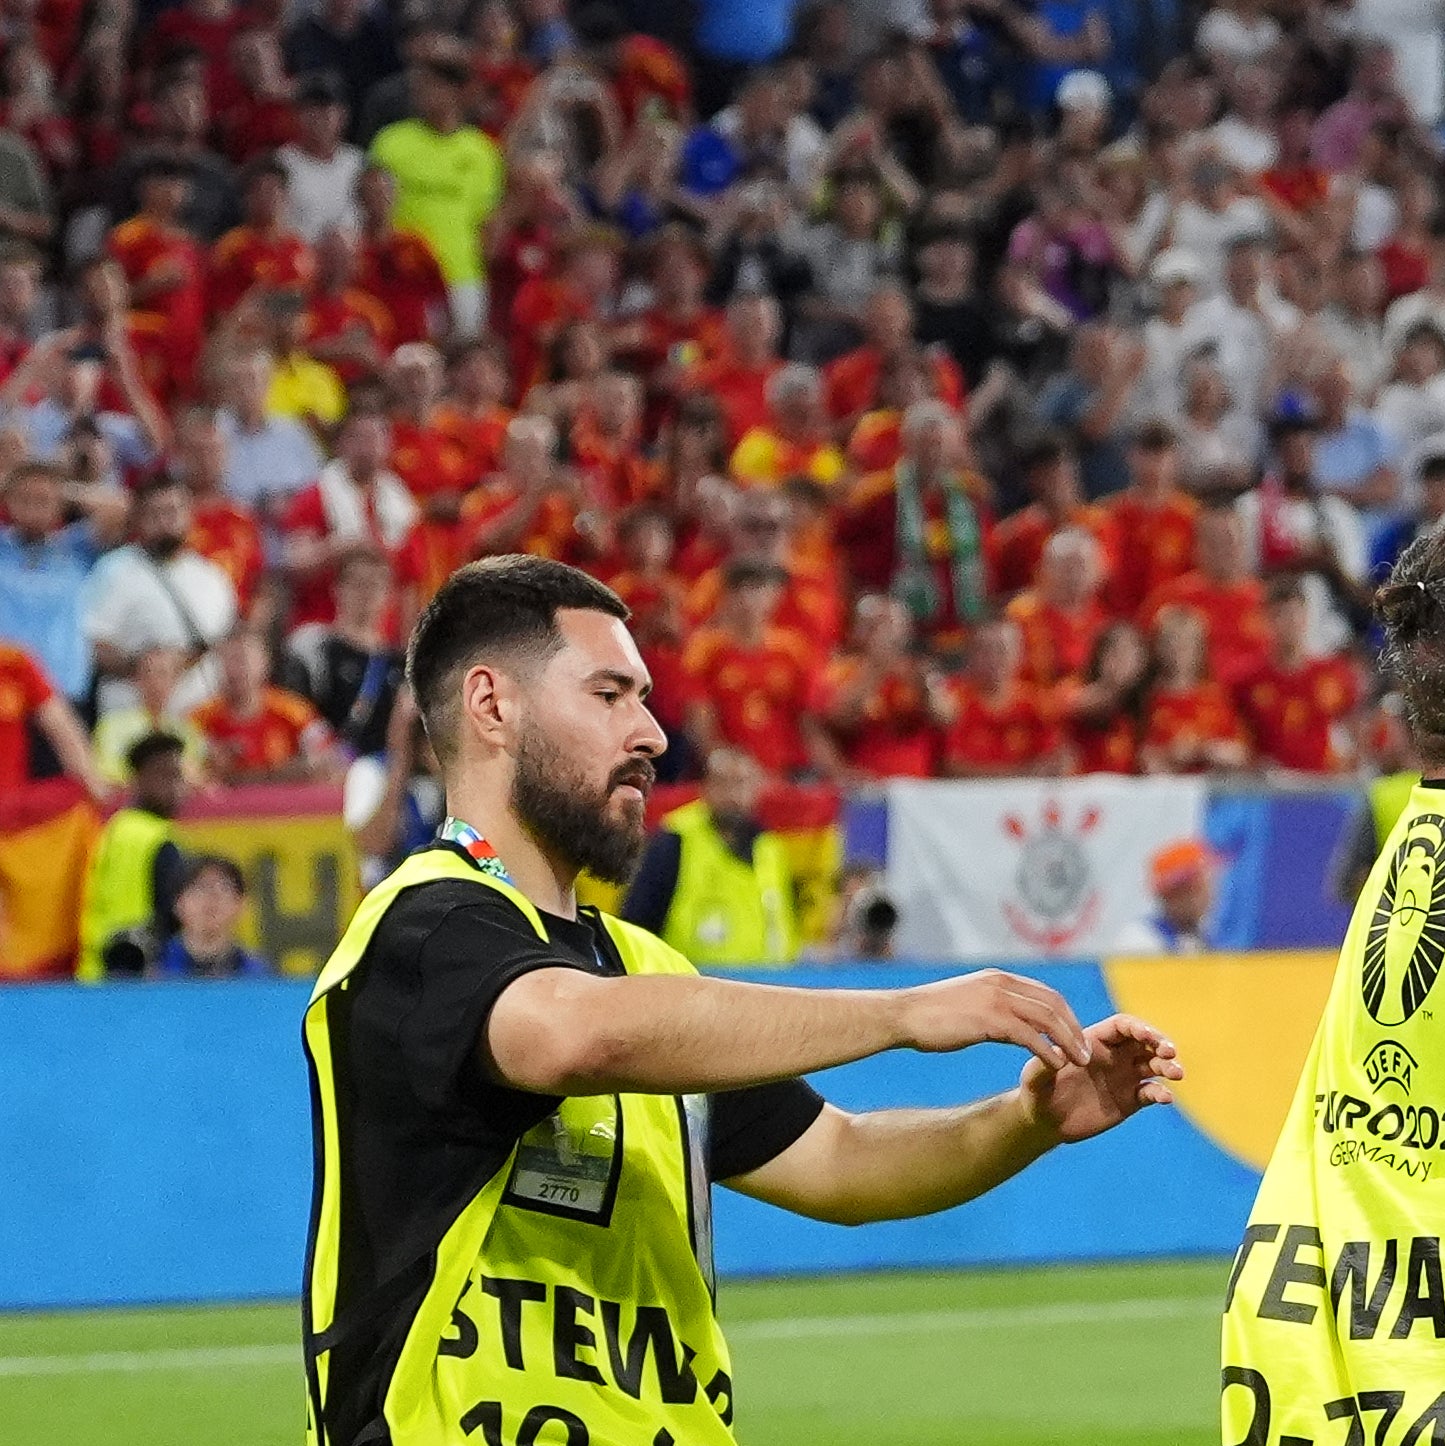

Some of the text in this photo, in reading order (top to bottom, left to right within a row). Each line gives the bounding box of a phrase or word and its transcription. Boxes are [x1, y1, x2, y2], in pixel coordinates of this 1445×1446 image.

[1366, 1049, 1412, 1090] UEFA
[1329, 1140, 1433, 1183] GERMANY
[538, 1183, 580, 1203] 2770
